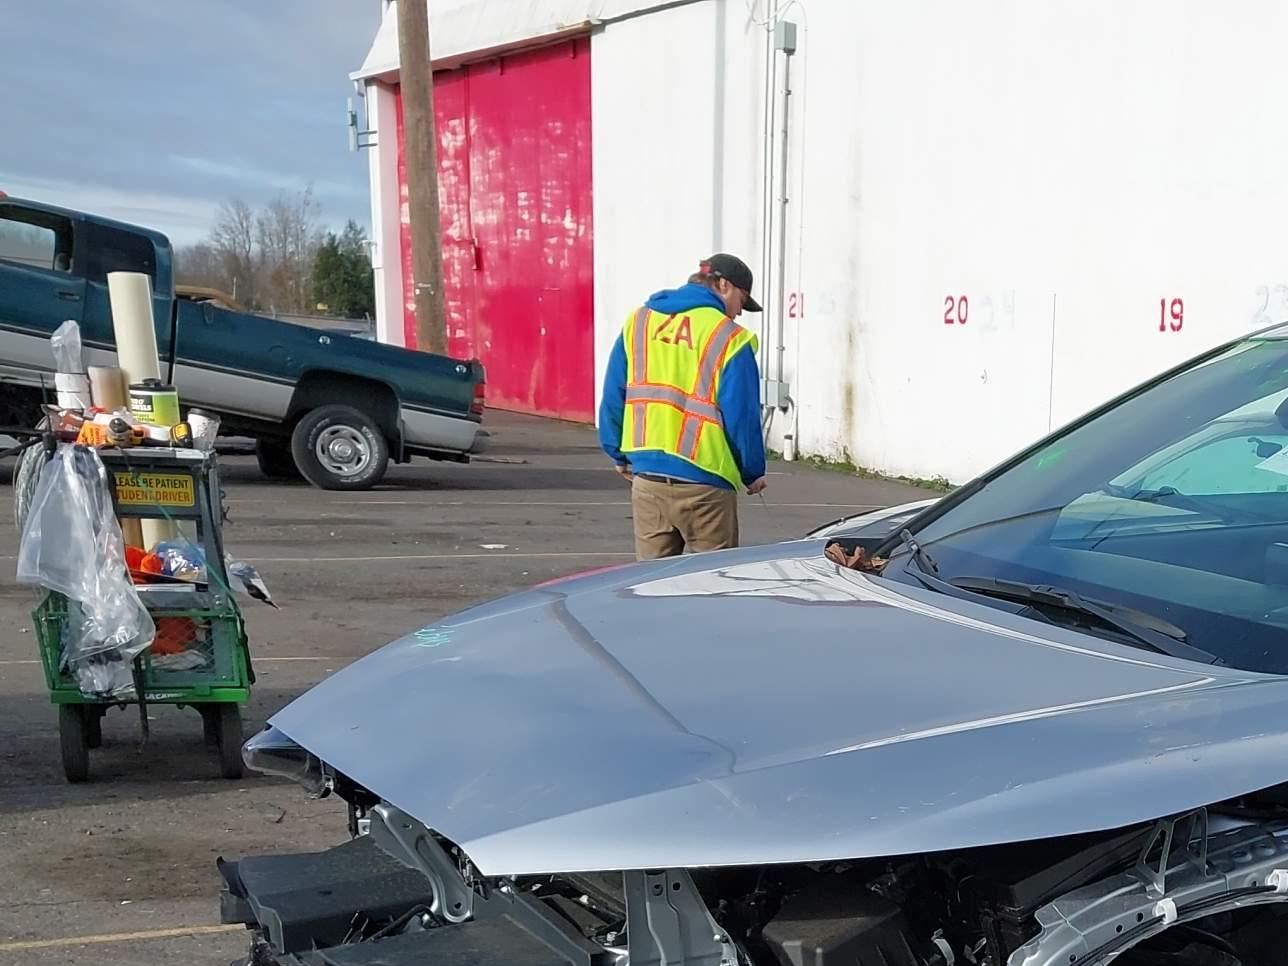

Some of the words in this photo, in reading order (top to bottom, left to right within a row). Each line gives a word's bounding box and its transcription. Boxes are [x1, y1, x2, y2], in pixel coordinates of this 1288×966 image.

[788, 293, 805, 318] 21
[944, 296, 968, 325] 20
[1158, 298, 1184, 332] 19
[156, 478, 189, 489] PATIENT
[156, 490, 190, 502] DRIVER
